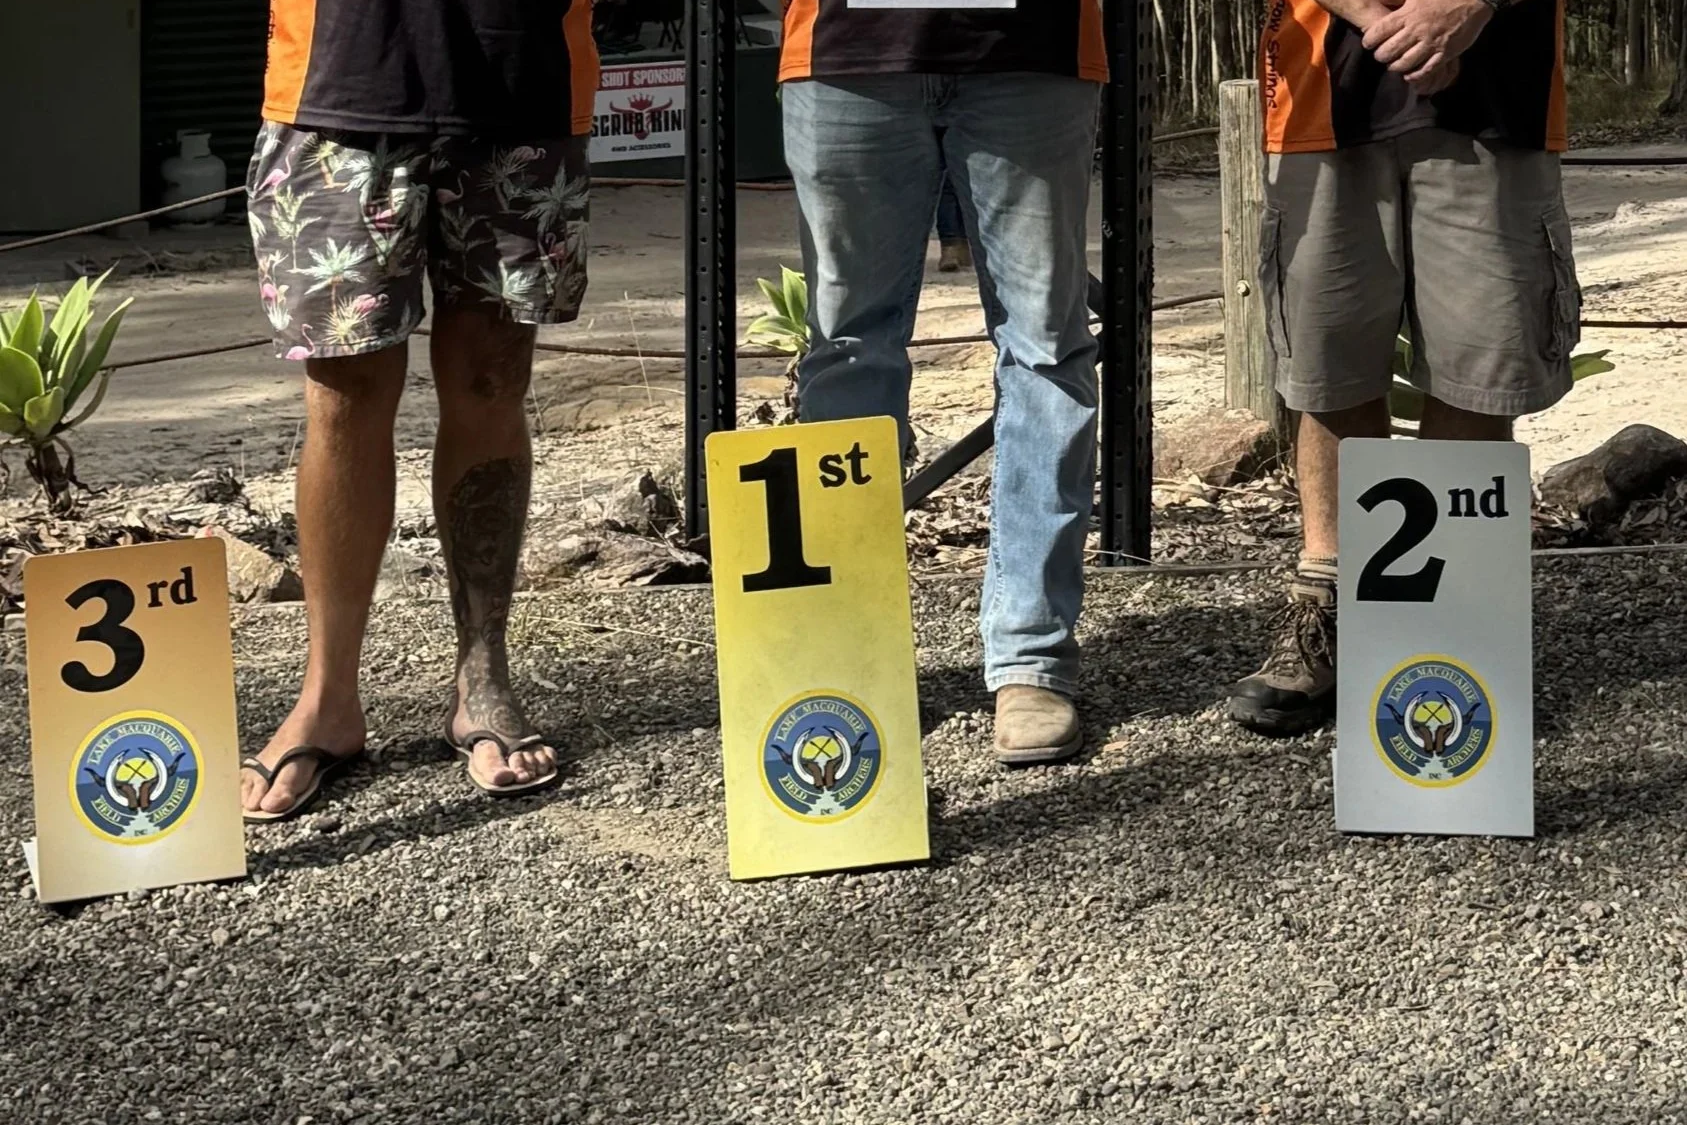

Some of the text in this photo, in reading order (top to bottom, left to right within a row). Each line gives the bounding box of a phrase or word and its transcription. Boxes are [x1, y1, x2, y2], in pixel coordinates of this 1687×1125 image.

[601, 67, 686, 87] SHOT SPONSOR
[591, 109, 686, 137] SCRUB KIN
[739, 442, 873, 593] 1st
[1356, 476, 1509, 603] 2nd
[60, 566, 198, 693] 3rd
[1389, 667, 1477, 703] LAKE MACQUARIE
[776, 702, 865, 741] LAKE MACQUARIE
[88, 724, 181, 765] LAKE MACQUARIE
[1392, 728, 1482, 767] FIELD ARCHERS
[781, 757, 872, 800] FIELD ARCHERS
[93, 778, 188, 822] FIELD ARCHERS
